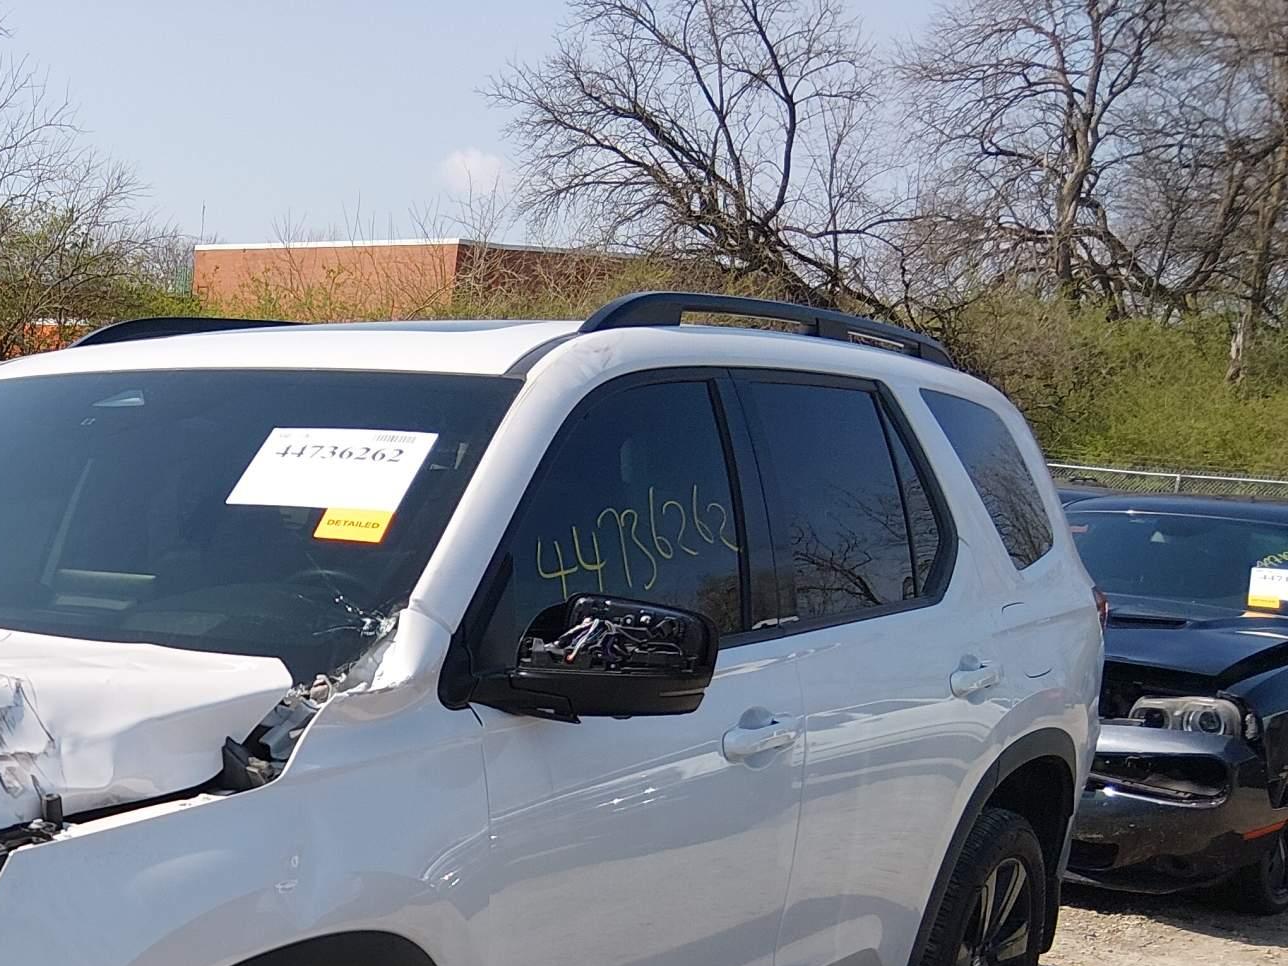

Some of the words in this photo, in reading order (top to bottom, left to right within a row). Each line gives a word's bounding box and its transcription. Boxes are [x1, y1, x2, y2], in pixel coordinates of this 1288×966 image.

[276, 444, 405, 463] 44736262
[326, 518, 380, 529] DETAILED
[536, 484, 742, 600] 44736262
